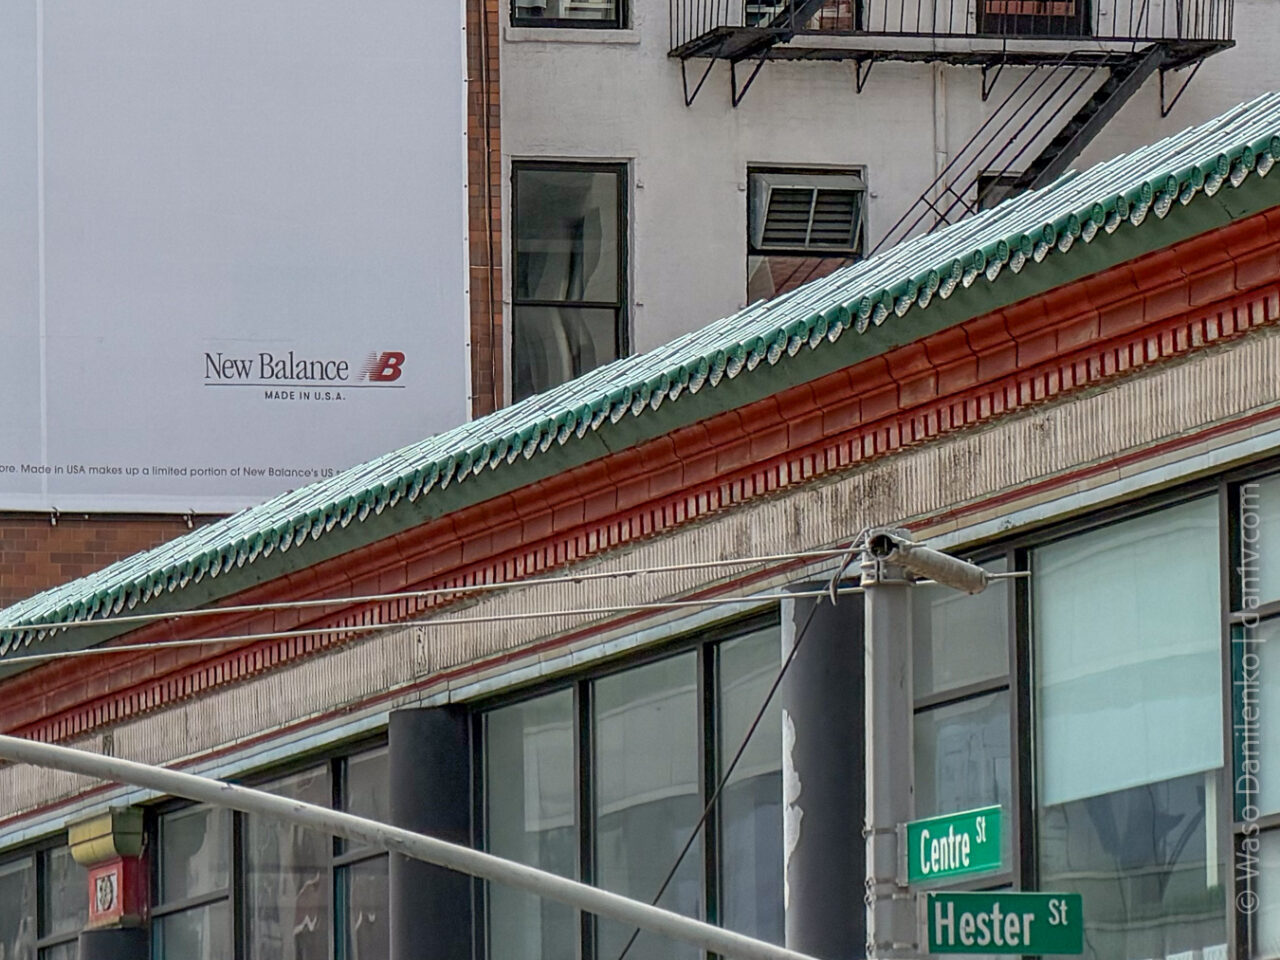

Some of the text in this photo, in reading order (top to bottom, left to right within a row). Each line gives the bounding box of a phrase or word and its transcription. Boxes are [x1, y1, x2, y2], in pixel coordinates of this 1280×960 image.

[204, 352, 253, 380] New
[258, 350, 349, 381] Balance
[264, 390, 347, 401] MADE IN U.S.A.
[20, 463, 52, 474] Made
[54, 464, 64, 475] in
[66, 464, 86, 475] USA
[88, 465, 123, 476] makes
[125, 466, 140, 478] up
[141, 467, 150, 476] a
[152, 465, 188, 477] limited
[189, 466, 228, 478] portion
[229, 466, 241, 477] of
[243, 466, 266, 477] New
[268, 466, 319, 478] Balance's
[320, 467, 334, 478] US
[920, 815, 987, 875] Centre St
[934, 898, 1069, 947] Hester St
